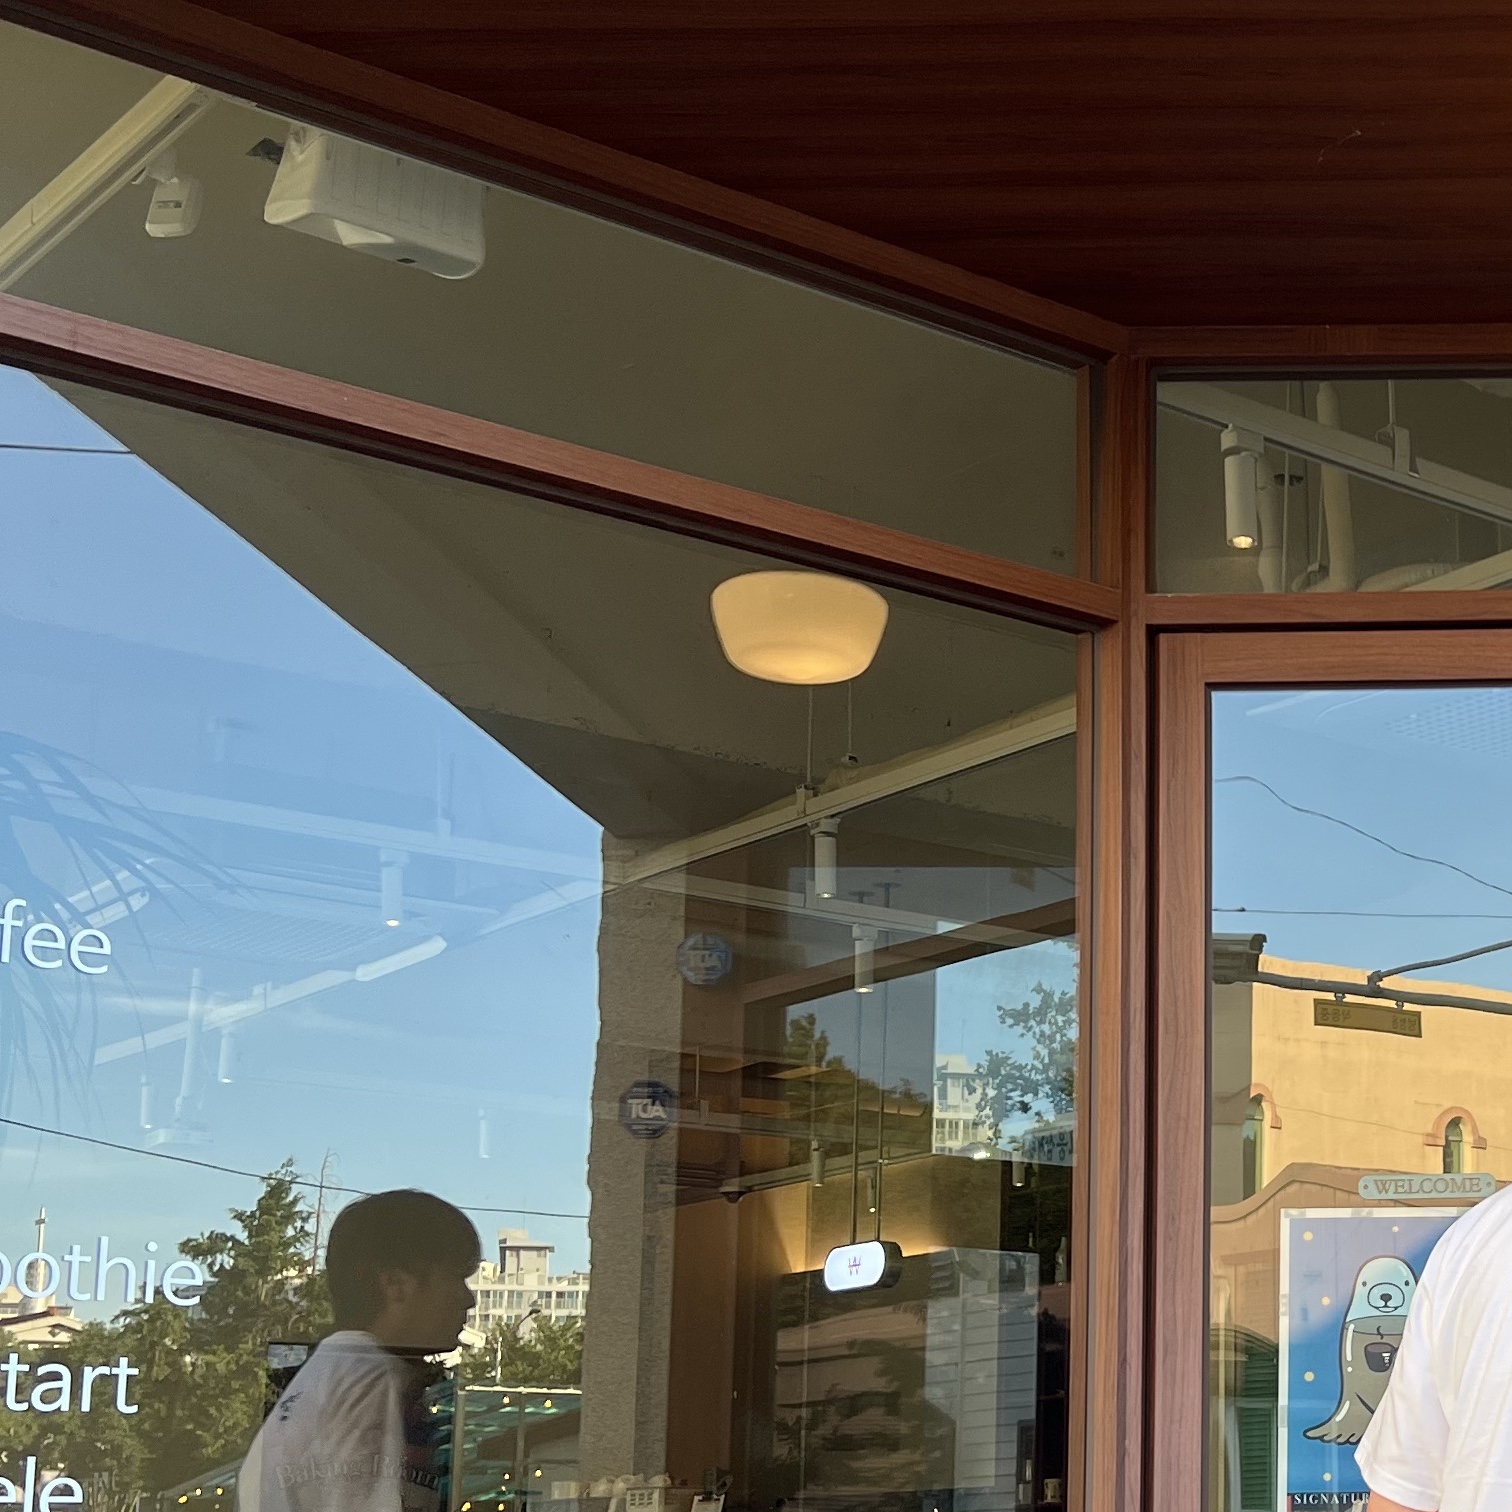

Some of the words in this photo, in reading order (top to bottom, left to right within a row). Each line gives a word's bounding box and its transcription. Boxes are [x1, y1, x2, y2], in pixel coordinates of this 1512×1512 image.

[1373, 1177, 1483, 1195] WELCOME
[0, 1235, 205, 1307] othie
[0, 1352, 140, 1415] tart
